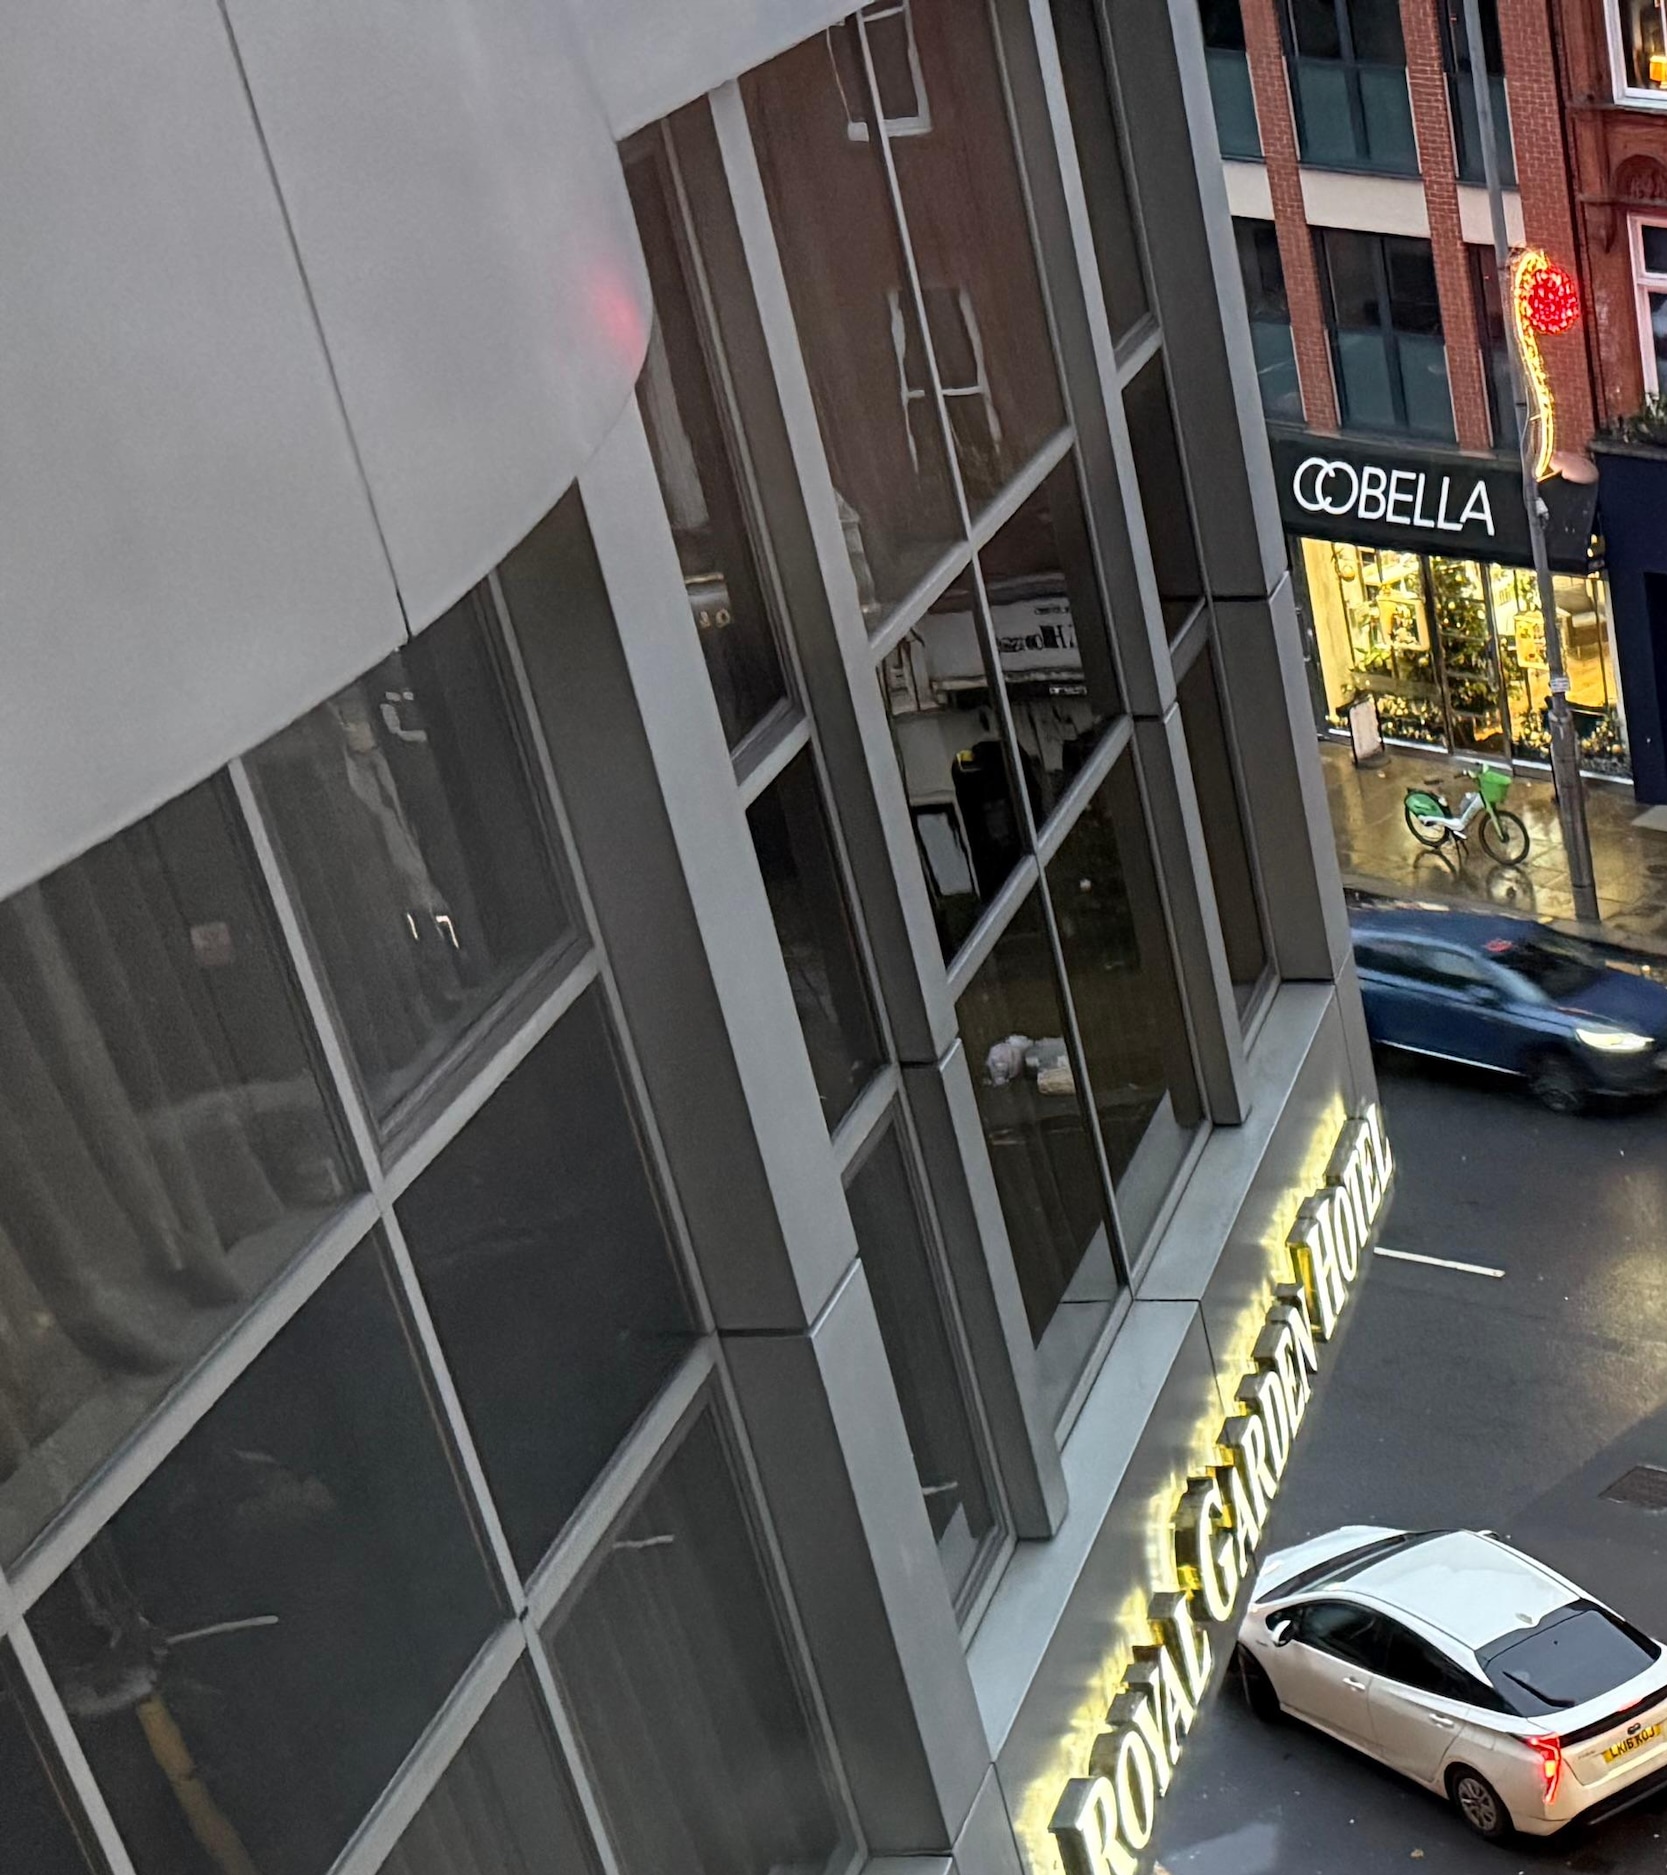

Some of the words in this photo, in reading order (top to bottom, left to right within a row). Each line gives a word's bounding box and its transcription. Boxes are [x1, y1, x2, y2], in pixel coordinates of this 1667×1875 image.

[1293, 457, 1495, 536] COBELLA
[1196, 1287, 1318, 1622] GARDEN
[1304, 1103, 1396, 1342] HOTEL
